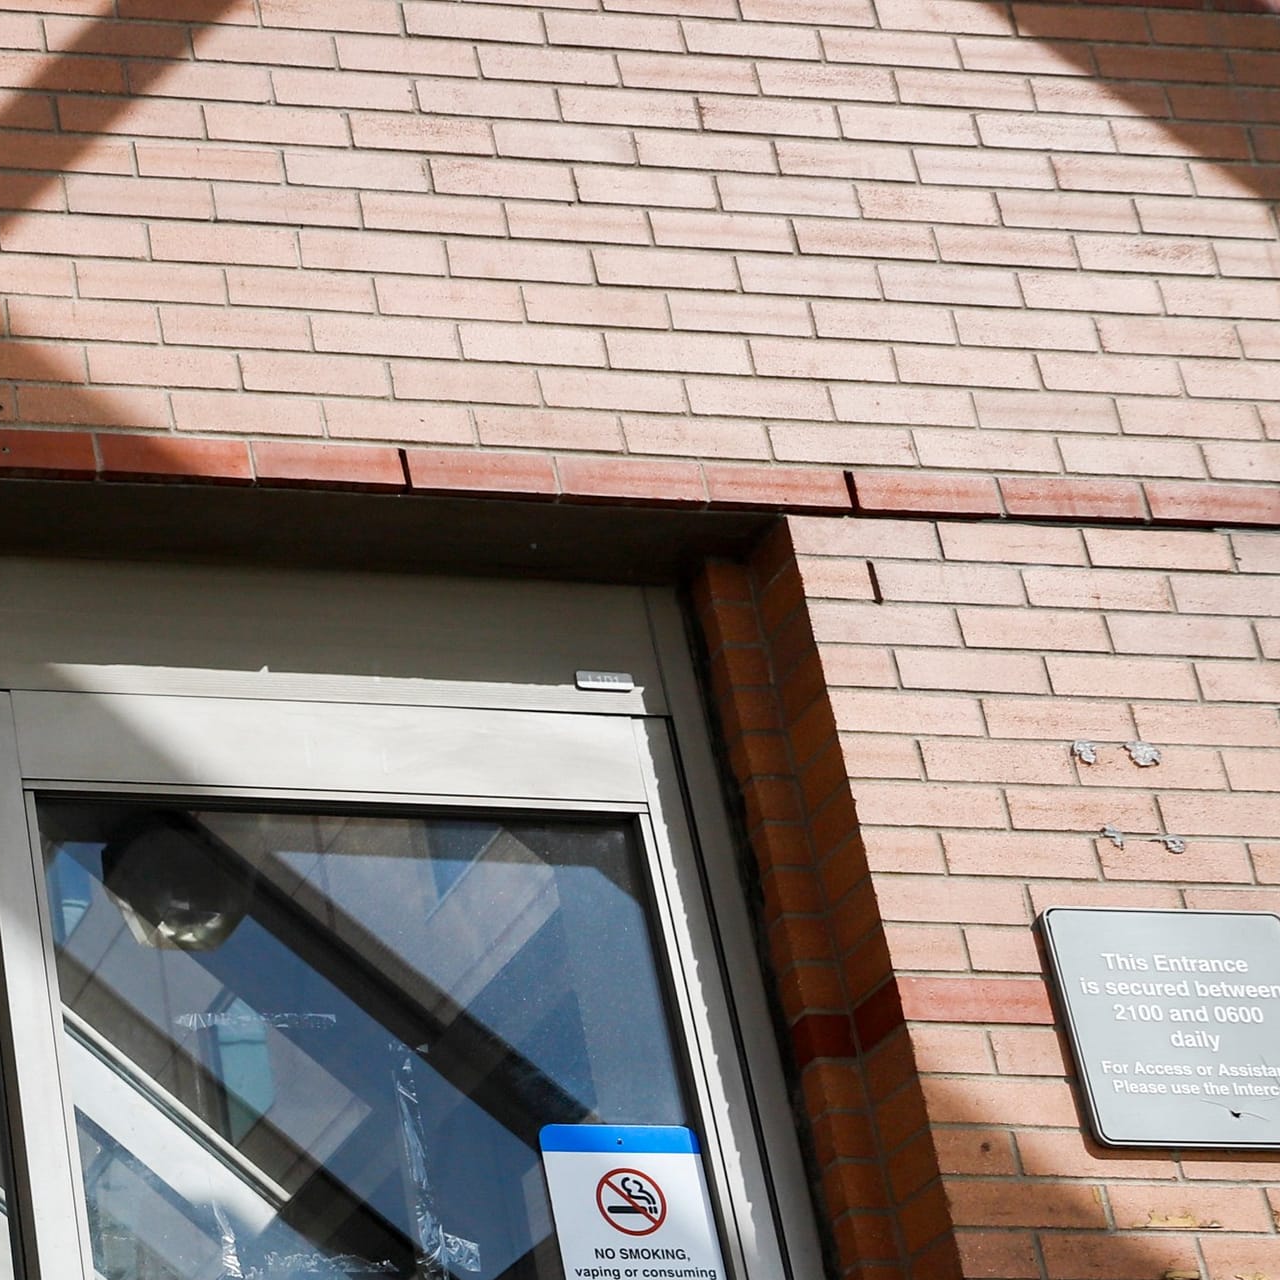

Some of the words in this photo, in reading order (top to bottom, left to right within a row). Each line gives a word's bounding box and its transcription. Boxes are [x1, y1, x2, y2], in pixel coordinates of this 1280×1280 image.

[1101, 953, 1148, 971] This
[1153, 954, 1249, 973] Entrance
[1079, 976, 1100, 995] is
[1105, 980, 1190, 997] secured
[1113, 1004, 1163, 1021] 2100
[1169, 1005, 1209, 1022] and
[1214, 1006, 1264, 1024] 0600
[1170, 1030, 1220, 1051] daily
[1101, 1060, 1129, 1074] For
[1134, 1061, 1192, 1075] Access
[1196, 1065, 1213, 1075] or
[1113, 1079, 1167, 1094] Please
[1170, 1083, 1200, 1095] use
[1203, 1081, 1230, 1095] the
[594, 1248, 616, 1260] NO
[620, 1248, 691, 1262] SMOKING,
[575, 1266, 621, 1280] vaping
[624, 1268, 638, 1277] or
[642, 1267, 717, 1280] consuming
